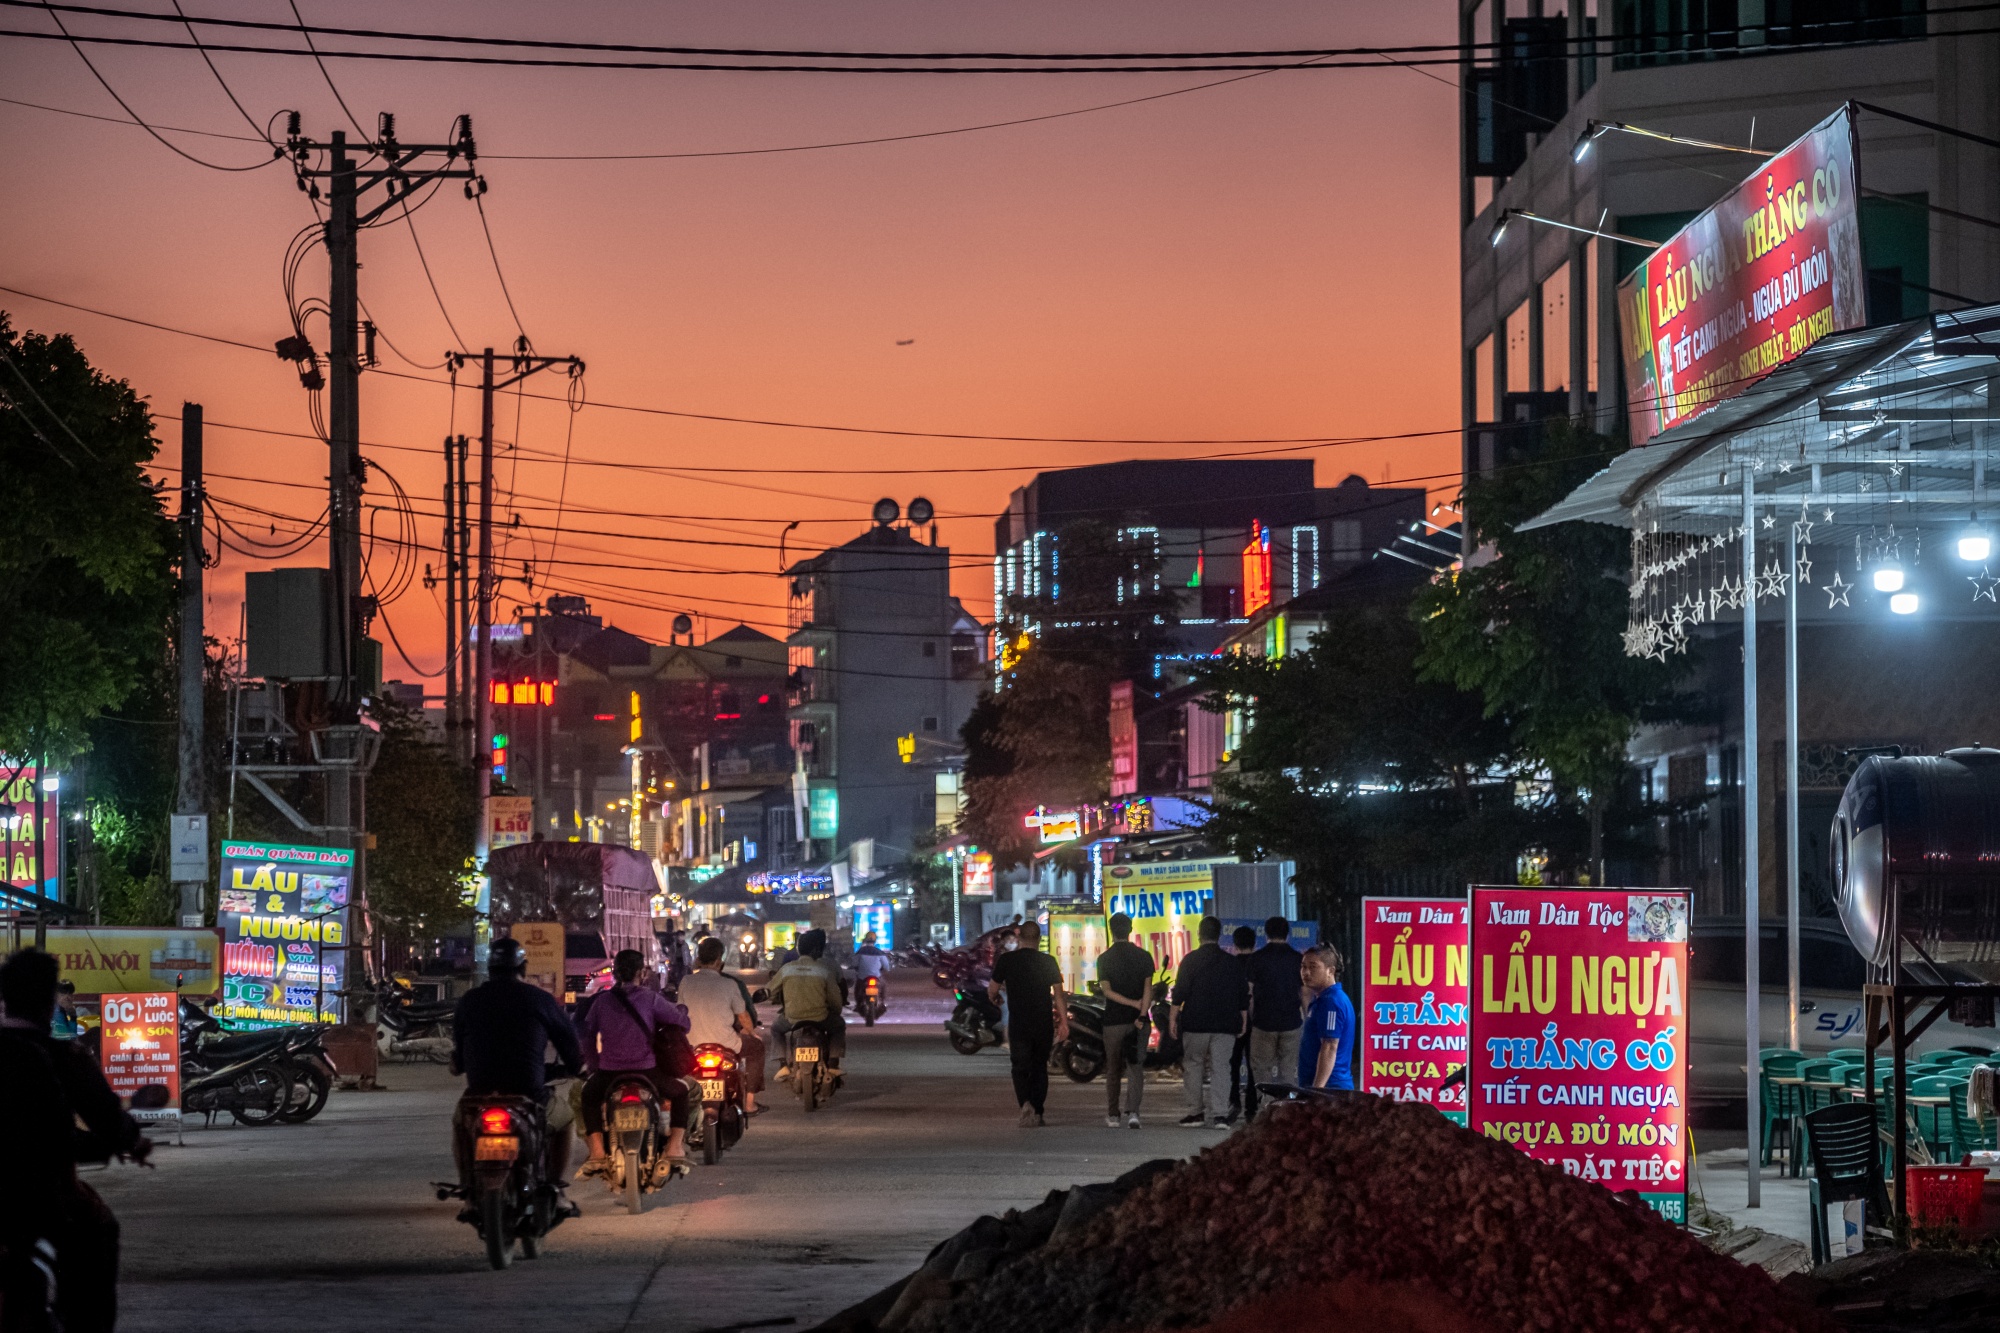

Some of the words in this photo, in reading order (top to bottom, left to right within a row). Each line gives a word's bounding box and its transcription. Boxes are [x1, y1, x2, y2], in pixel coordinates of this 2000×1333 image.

[1674, 325, 1692, 373] TIẾT
[1693, 318, 1719, 361] CANH
[1753, 277, 1782, 325] NGỰA
[1783, 252, 1800, 305] ĐỦ
[1801, 245, 1828, 294] MÓN
[1739, 346, 1760, 379] SINH
[226, 845, 265, 857] QUÁN
[320, 850, 349, 863] ĐÀO
[266, 894, 285, 913] &
[1375, 906, 1412, 923] Nam
[1418, 907, 1454, 924] Dân
[1487, 901, 1530, 925] Nam
[1538, 902, 1580, 926] Dân
[1587, 901, 1624, 933] Tộc
[64, 949, 98, 971] HÀ
[102, 950, 140, 975] NỘI
[1371, 926, 1434, 987] LẨU
[1483, 930, 1557, 1015] LẨU
[1571, 951, 1682, 1029] NGỰA
[104, 997, 135, 1023] ỐC
[145, 1012, 174, 1024] LUỘC
[235, 1004, 259, 1019] MÓN
[1371, 1029, 1412, 1050] TIẾT
[1486, 1022, 1618, 1070] THẮNG
[1625, 1026, 1676, 1071] CỐ
[134, 1052, 145, 1062] GÀ
[161, 1065, 176, 1073] TIM
[1372, 1060, 1441, 1081] NGỰA
[1482, 1076, 1531, 1104] TIẾT
[1537, 1084, 1604, 1105] CANH
[1610, 1084, 1680, 1113] NGỰA
[1482, 1120, 1564, 1149] NGỰA
[1570, 1115, 1611, 1145] ĐỦ
[1617, 1118, 1679, 1146] MÓN
[1622, 1153, 1681, 1185] TIỆC
